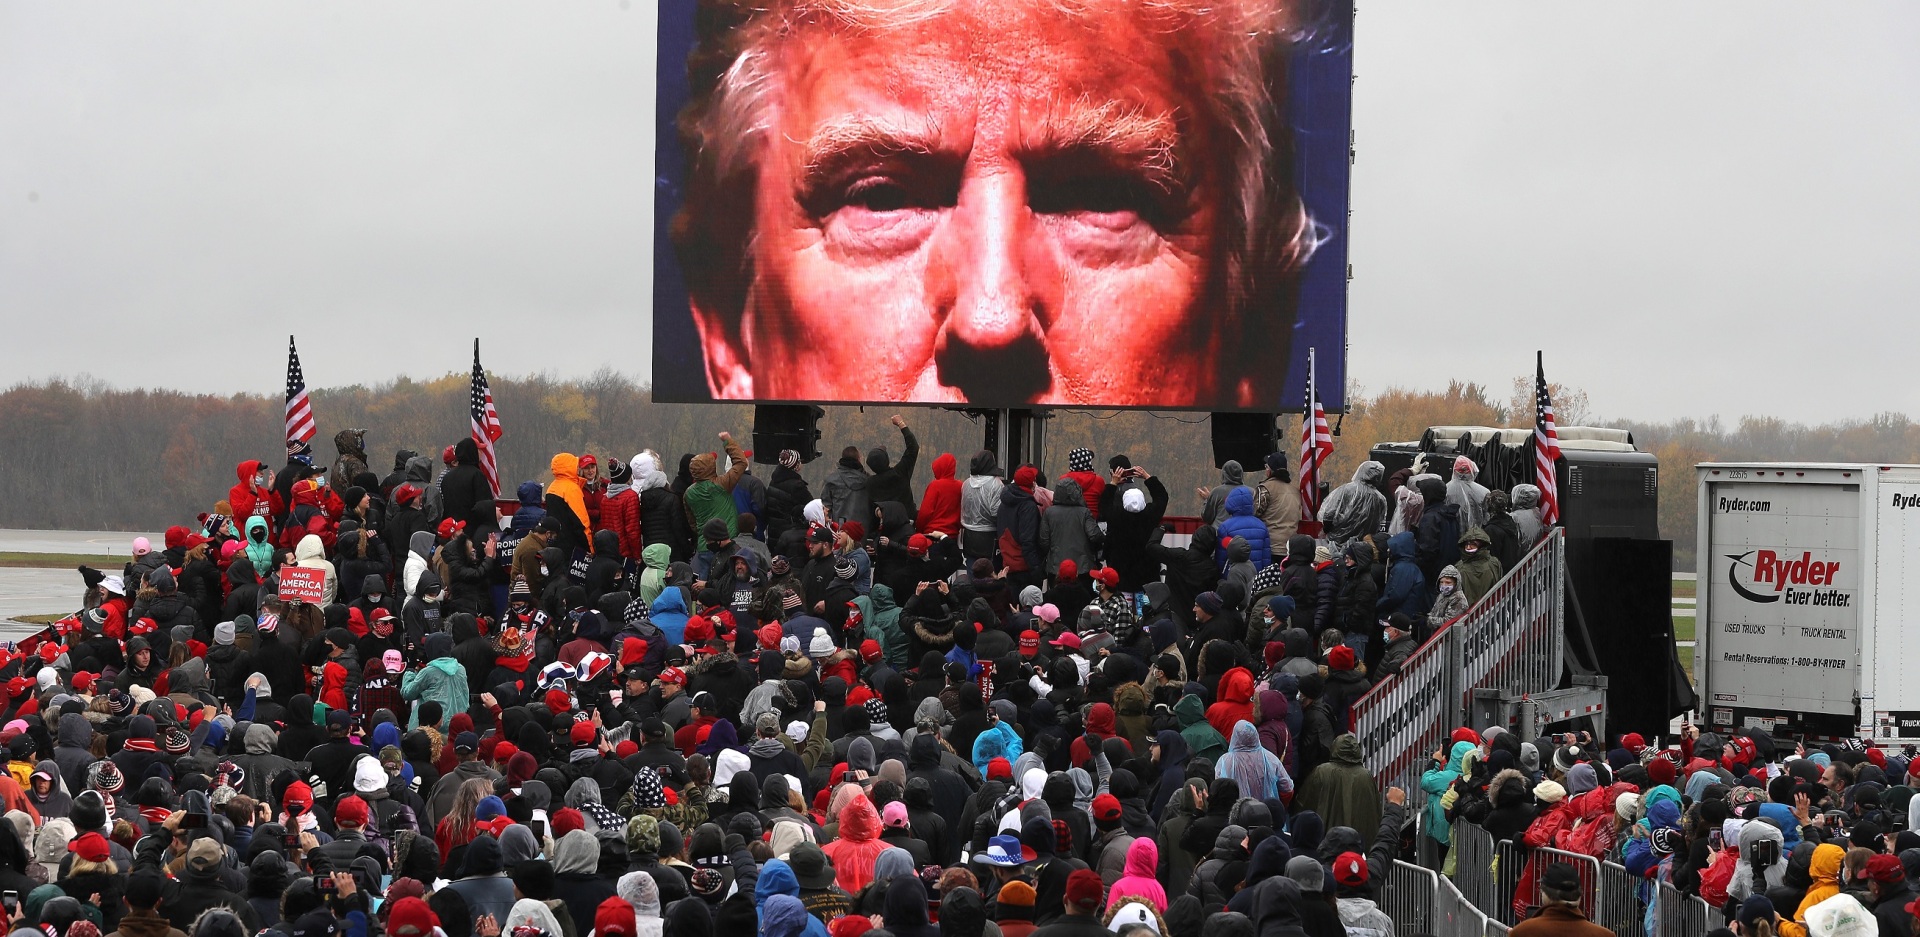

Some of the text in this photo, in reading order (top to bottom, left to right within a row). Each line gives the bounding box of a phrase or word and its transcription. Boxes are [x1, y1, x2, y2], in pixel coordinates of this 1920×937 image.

[1719, 496, 1771, 513] Ryder.com
[1892, 493, 1920, 510] Ryde
[496, 538, 524, 549] ROMIS
[1754, 550, 1840, 591] Ryder
[280, 579, 322, 590] AMERICA
[299, 590, 321, 598] AGAIN
[1784, 587, 1851, 607] Ever better.
[1724, 623, 1766, 635] USED TRUCKS
[1801, 627, 1847, 640] TRUCK RENTAL
[1723, 652, 1846, 669] Rental Reservations: 1-800-BY-RYDER
